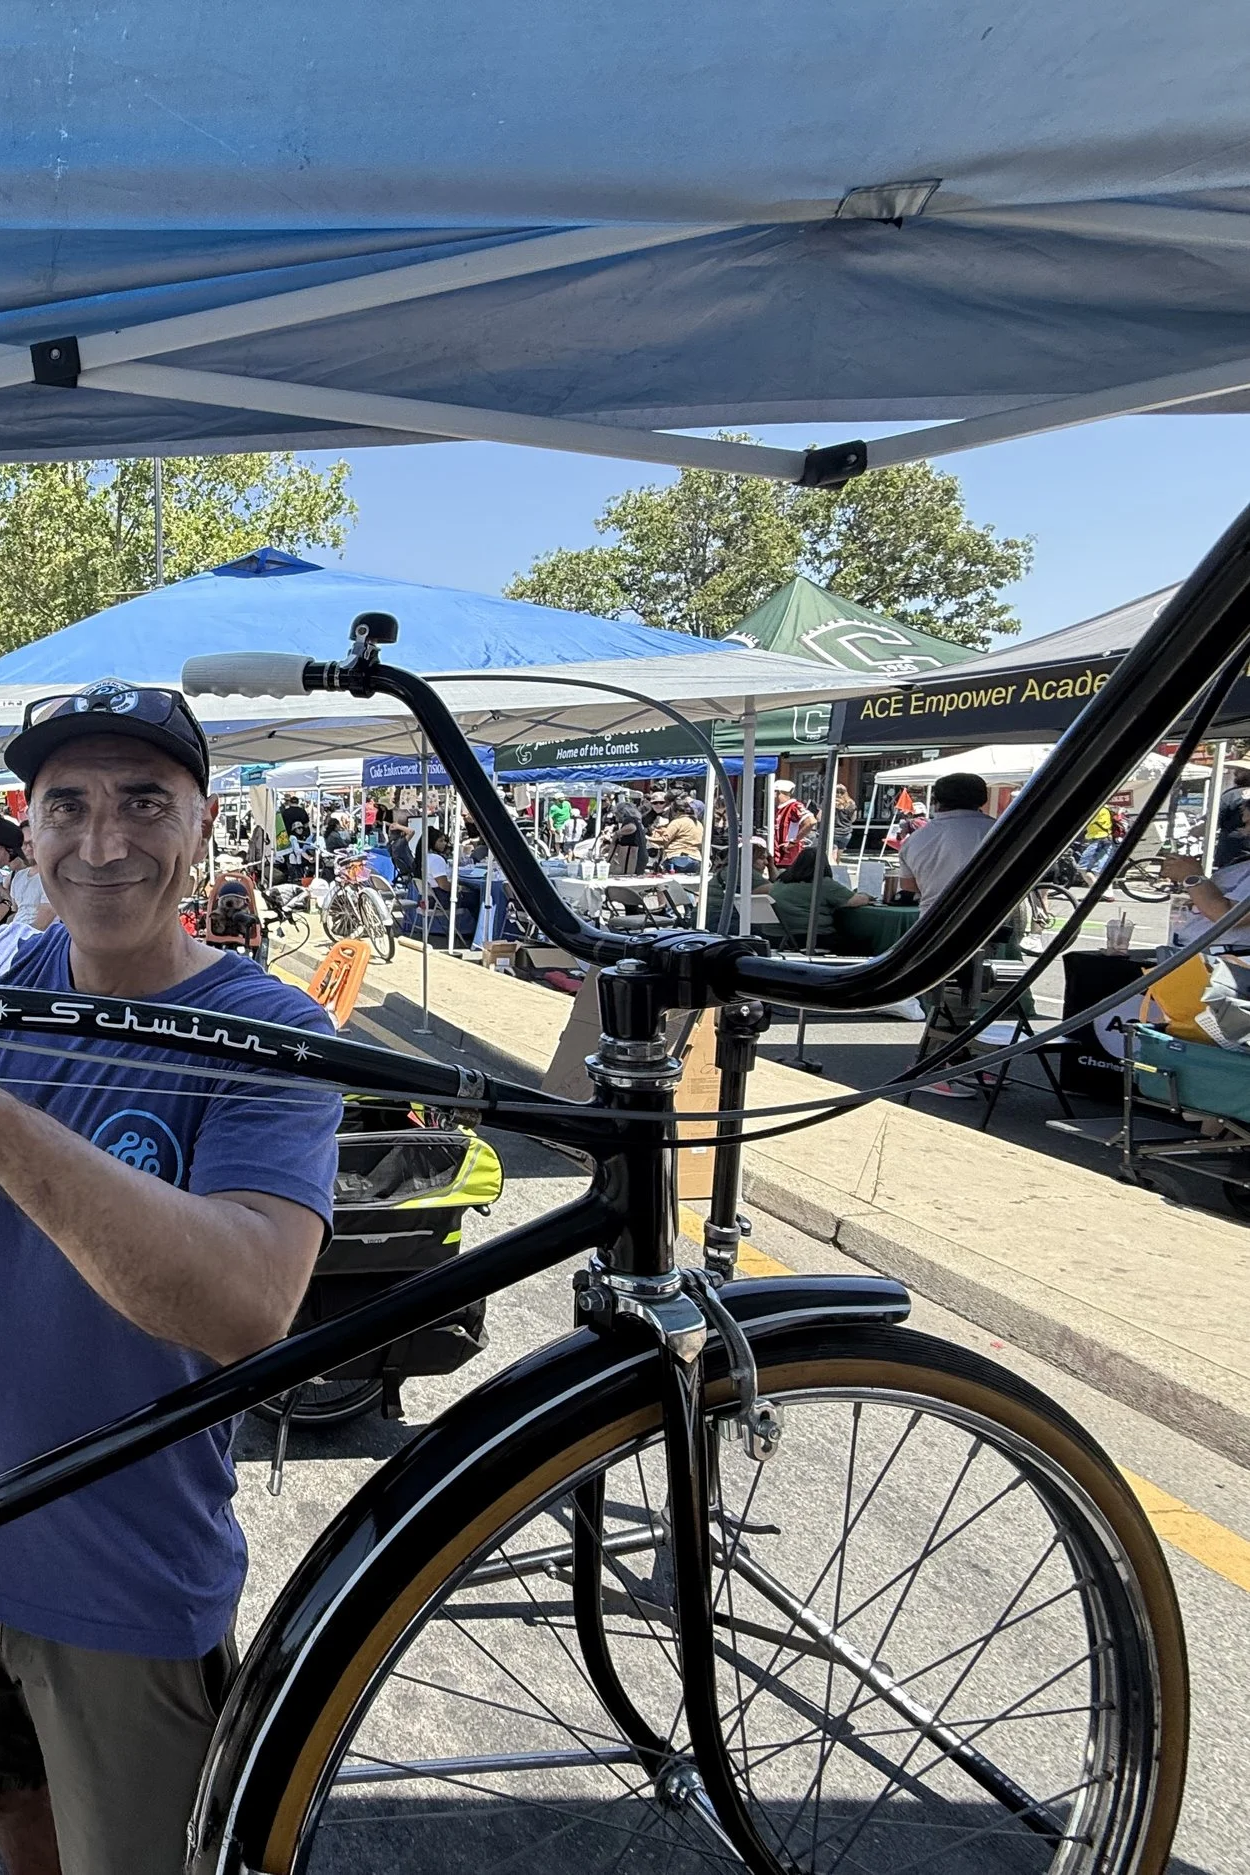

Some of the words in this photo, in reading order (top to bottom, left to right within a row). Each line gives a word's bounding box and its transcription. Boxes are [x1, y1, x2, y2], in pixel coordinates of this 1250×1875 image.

[877, 663, 919, 674] 1950
[860, 695, 903, 720] ACE
[909, 684, 1017, 717] Empower
[1020, 669, 1111, 703] Acade
[556, 748, 578, 760] Home
[580, 744, 589, 757] of
[589, 744, 603, 756] the
[605, 742, 639, 755] Comets
[370, 764, 383, 778] Code
[383, 762, 418, 777] Enforcement
[22, 1001, 278, 1056] Schwinn
[1078, 1056, 1124, 1073] Charter
